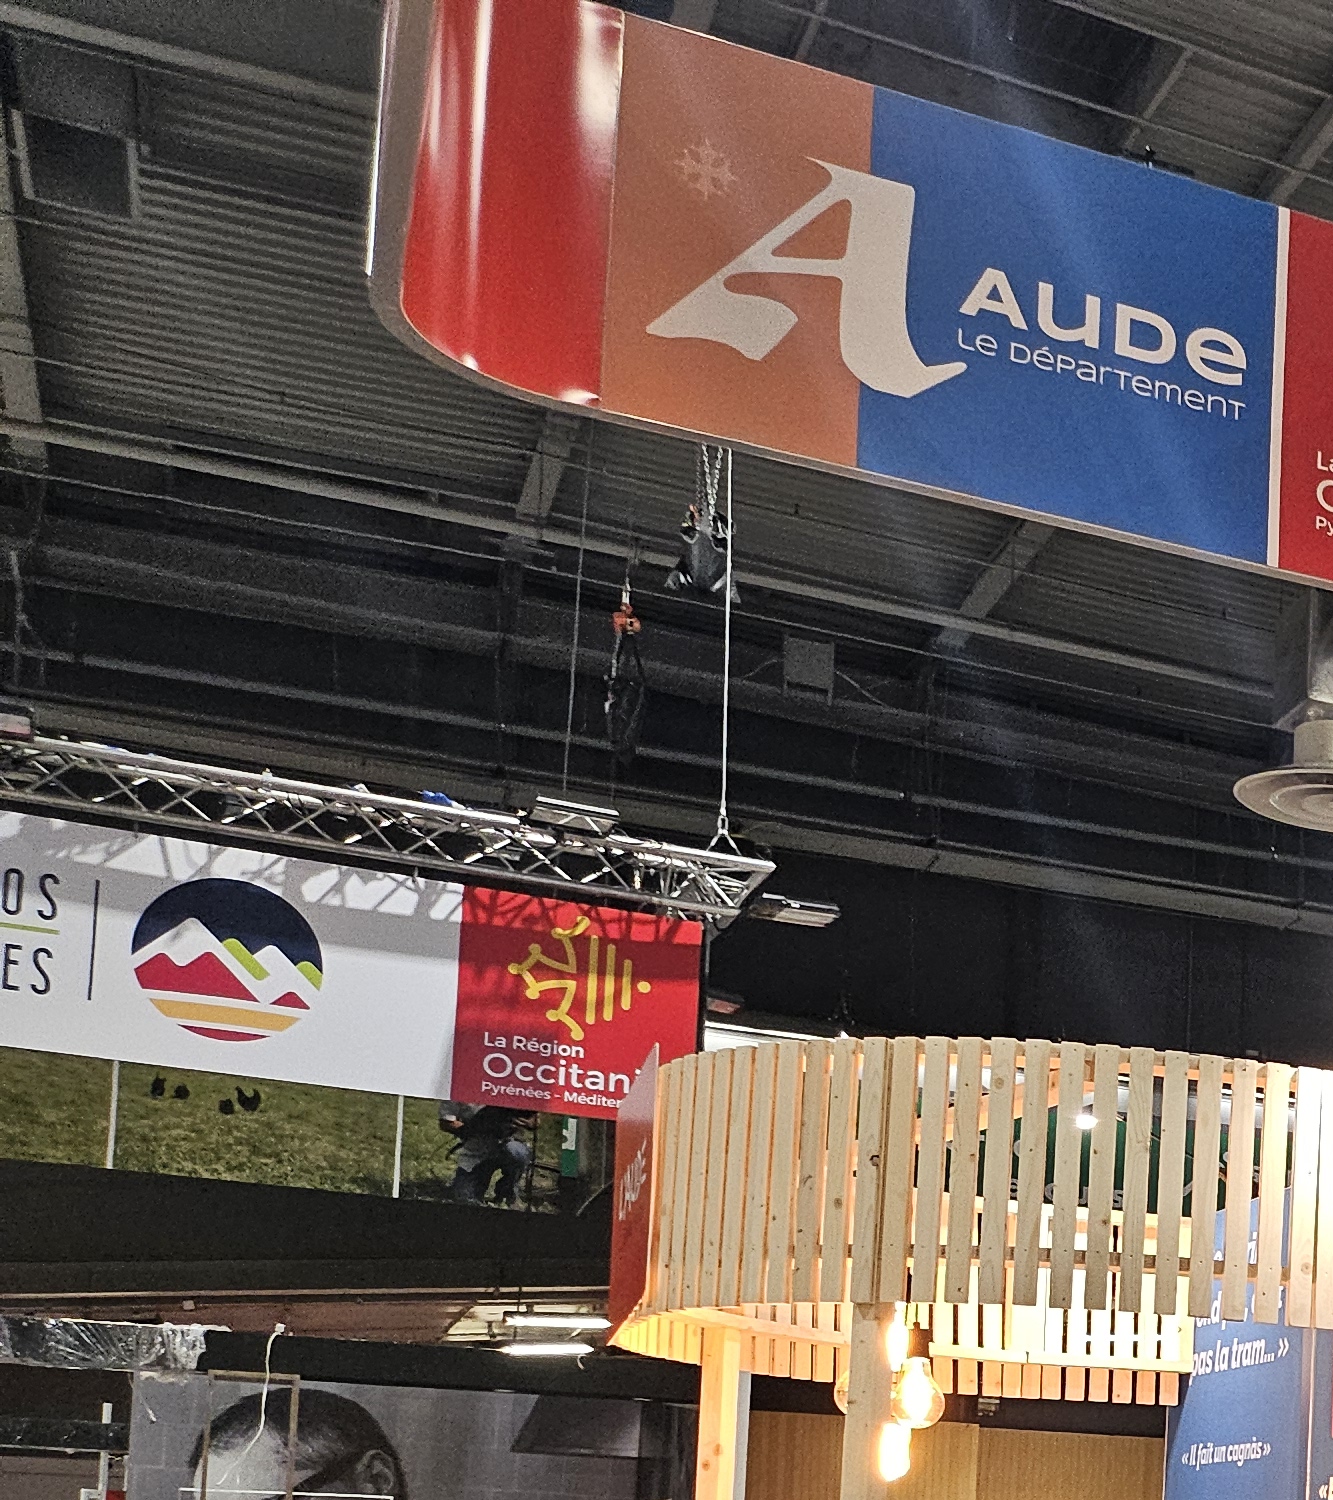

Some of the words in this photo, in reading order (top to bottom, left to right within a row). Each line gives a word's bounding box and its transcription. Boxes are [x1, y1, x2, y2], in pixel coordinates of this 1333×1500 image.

[483, 1032, 507, 1049] La
[513, 1036, 585, 1058] Région
[483, 1052, 640, 1094] Occitan
[481, 1080, 551, 1100] Pyrénées
[1214, 1340, 1229, 1372] la
[1196, 1443, 1214, 1471] fait
[1214, 1447, 1227, 1464] un
